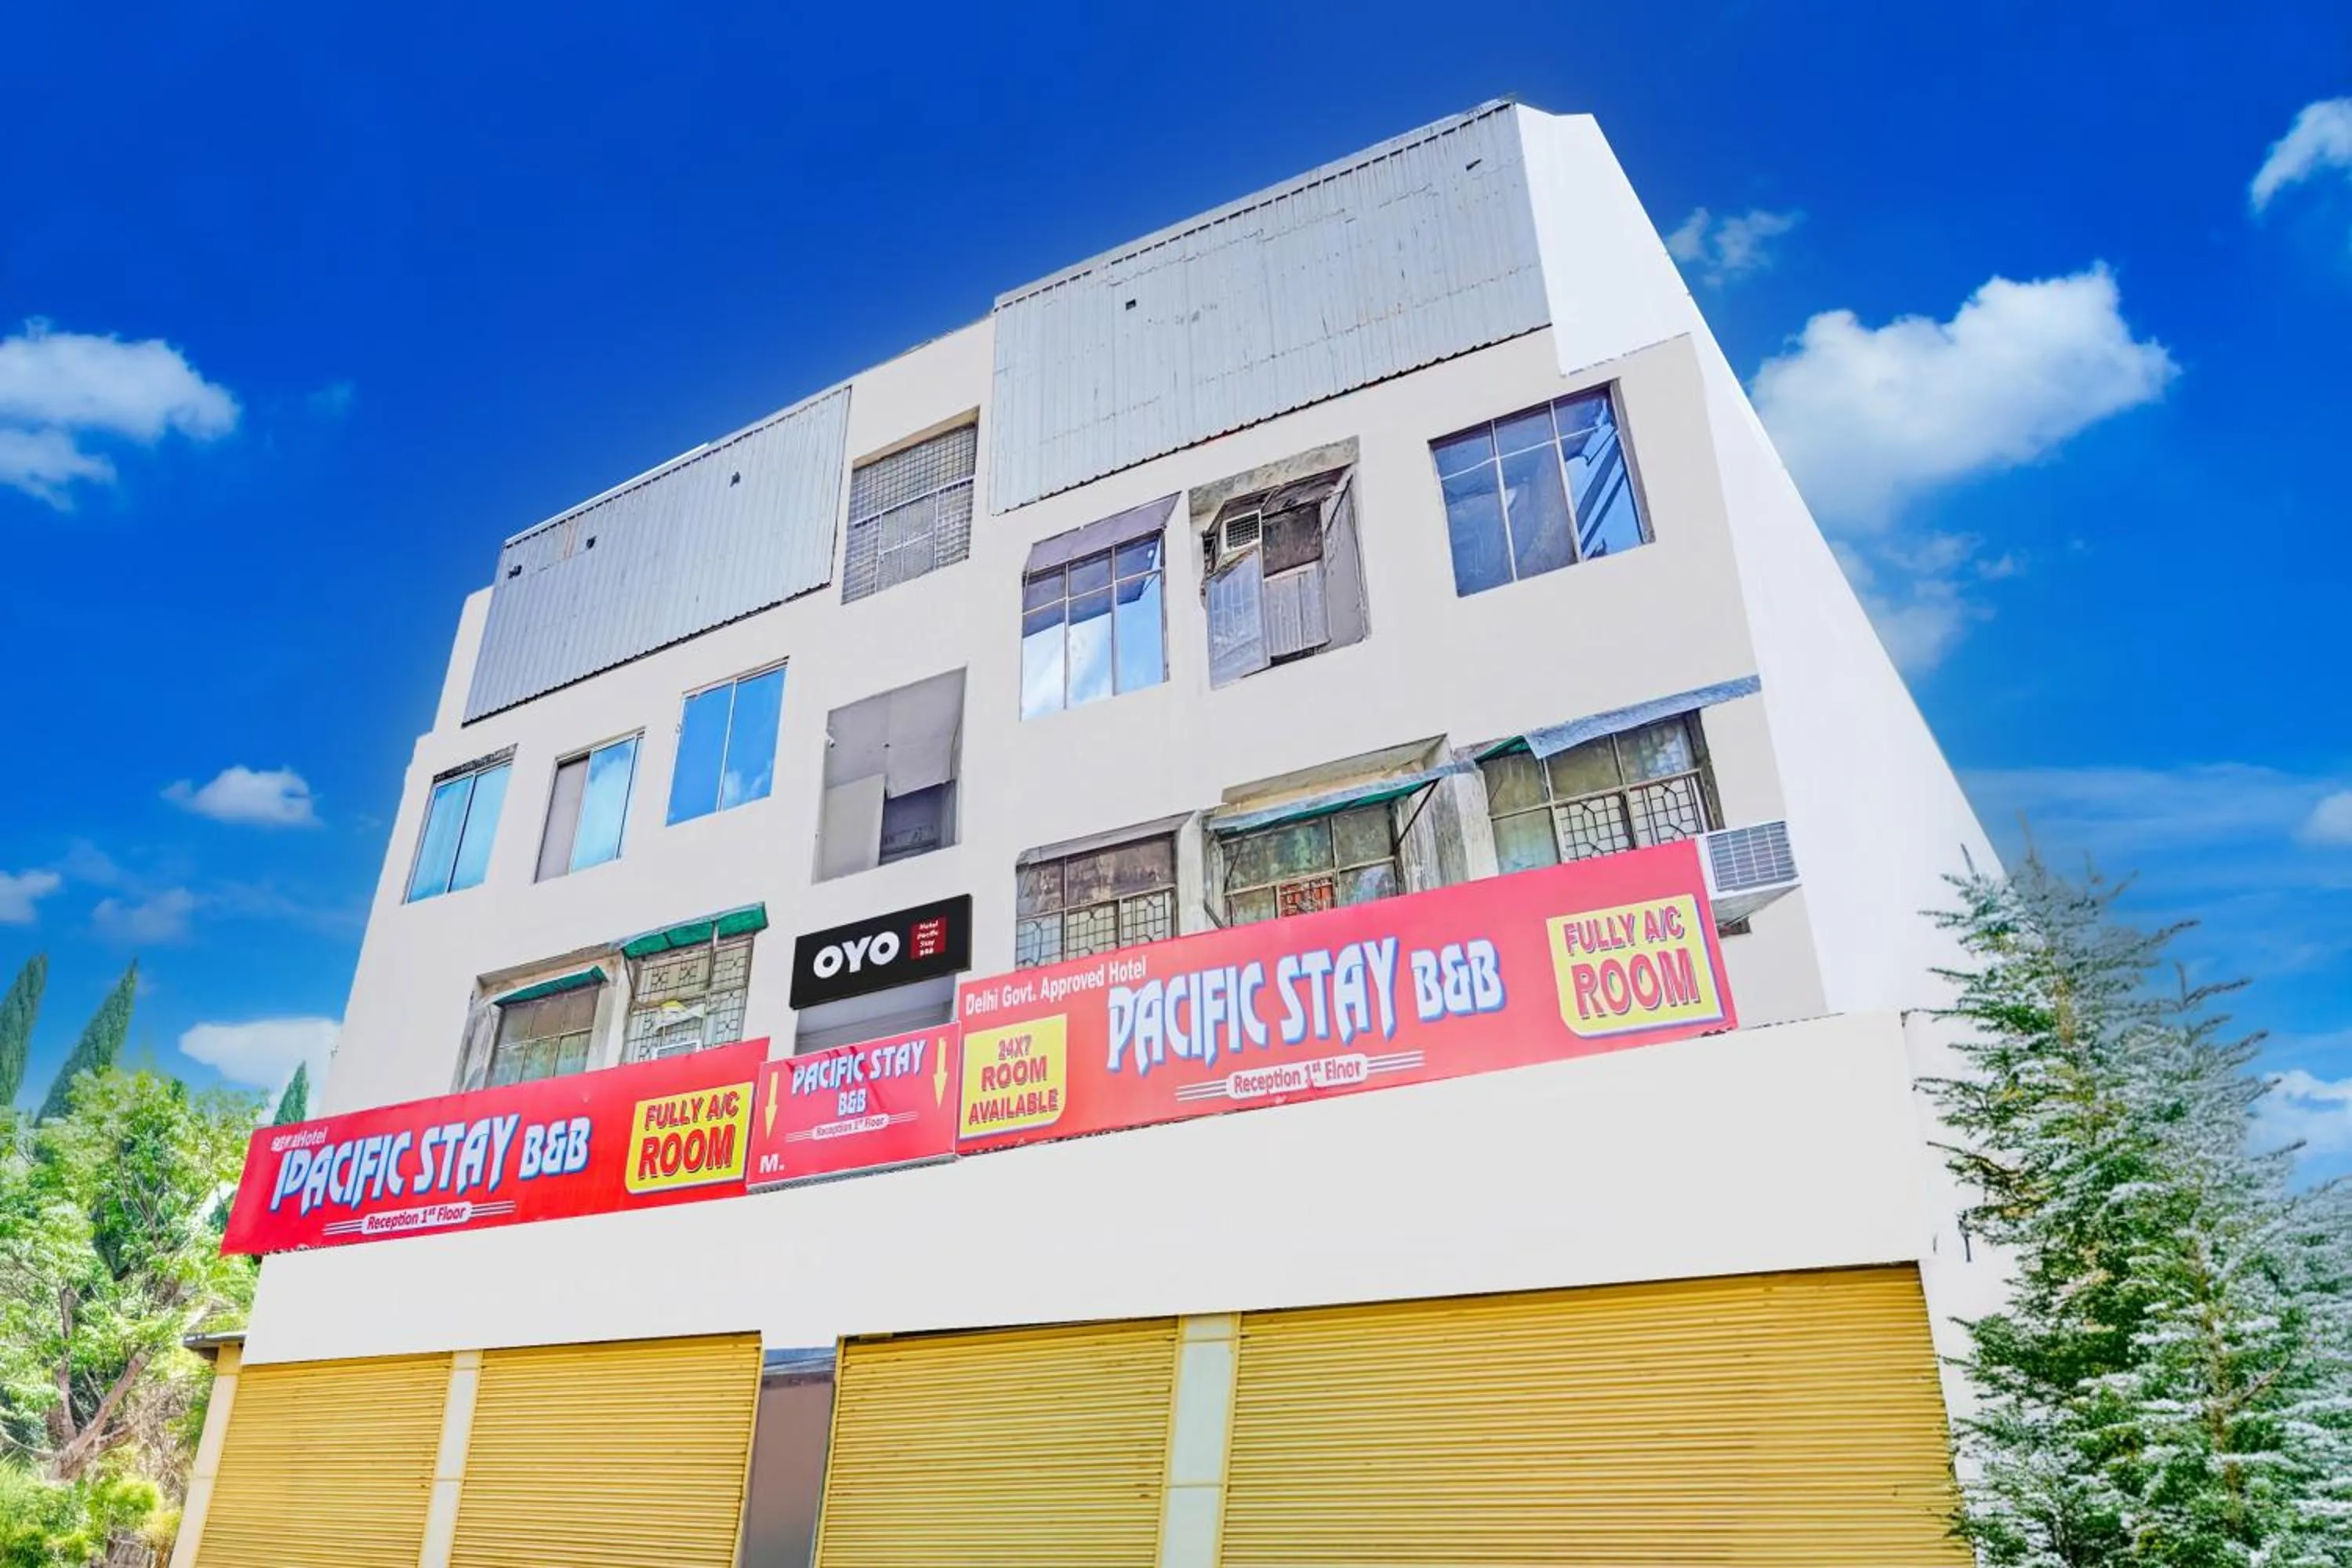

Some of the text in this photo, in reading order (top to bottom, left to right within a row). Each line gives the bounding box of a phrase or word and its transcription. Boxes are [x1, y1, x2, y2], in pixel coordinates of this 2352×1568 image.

[813, 931, 900, 978] OYO
[1563, 906, 1685, 956] FULLY A/C
[965, 955, 1146, 1016] Delhi Govt. Approved Hotel
[1106, 937, 1505, 1076] PACIFIC STAY B&B
[1570, 947, 1701, 1019] ROOM
[791, 1040, 927, 1096] PACIFIC STAY
[982, 1054, 1047, 1091] ROOM
[1234, 1068, 1301, 1095] Reception
[644, 1091, 740, 1131] FULLY A/C
[837, 1087, 868, 1116] B&B
[968, 1087, 1058, 1125] AVAILABLE
[269, 1114, 593, 1217] PACIFIC STAY B&B
[637, 1123, 736, 1181] ROOM
[759, 1154, 784, 1174] M.
[366, 1210, 419, 1230] Reception
[437, 1206, 466, 1221] Floor
